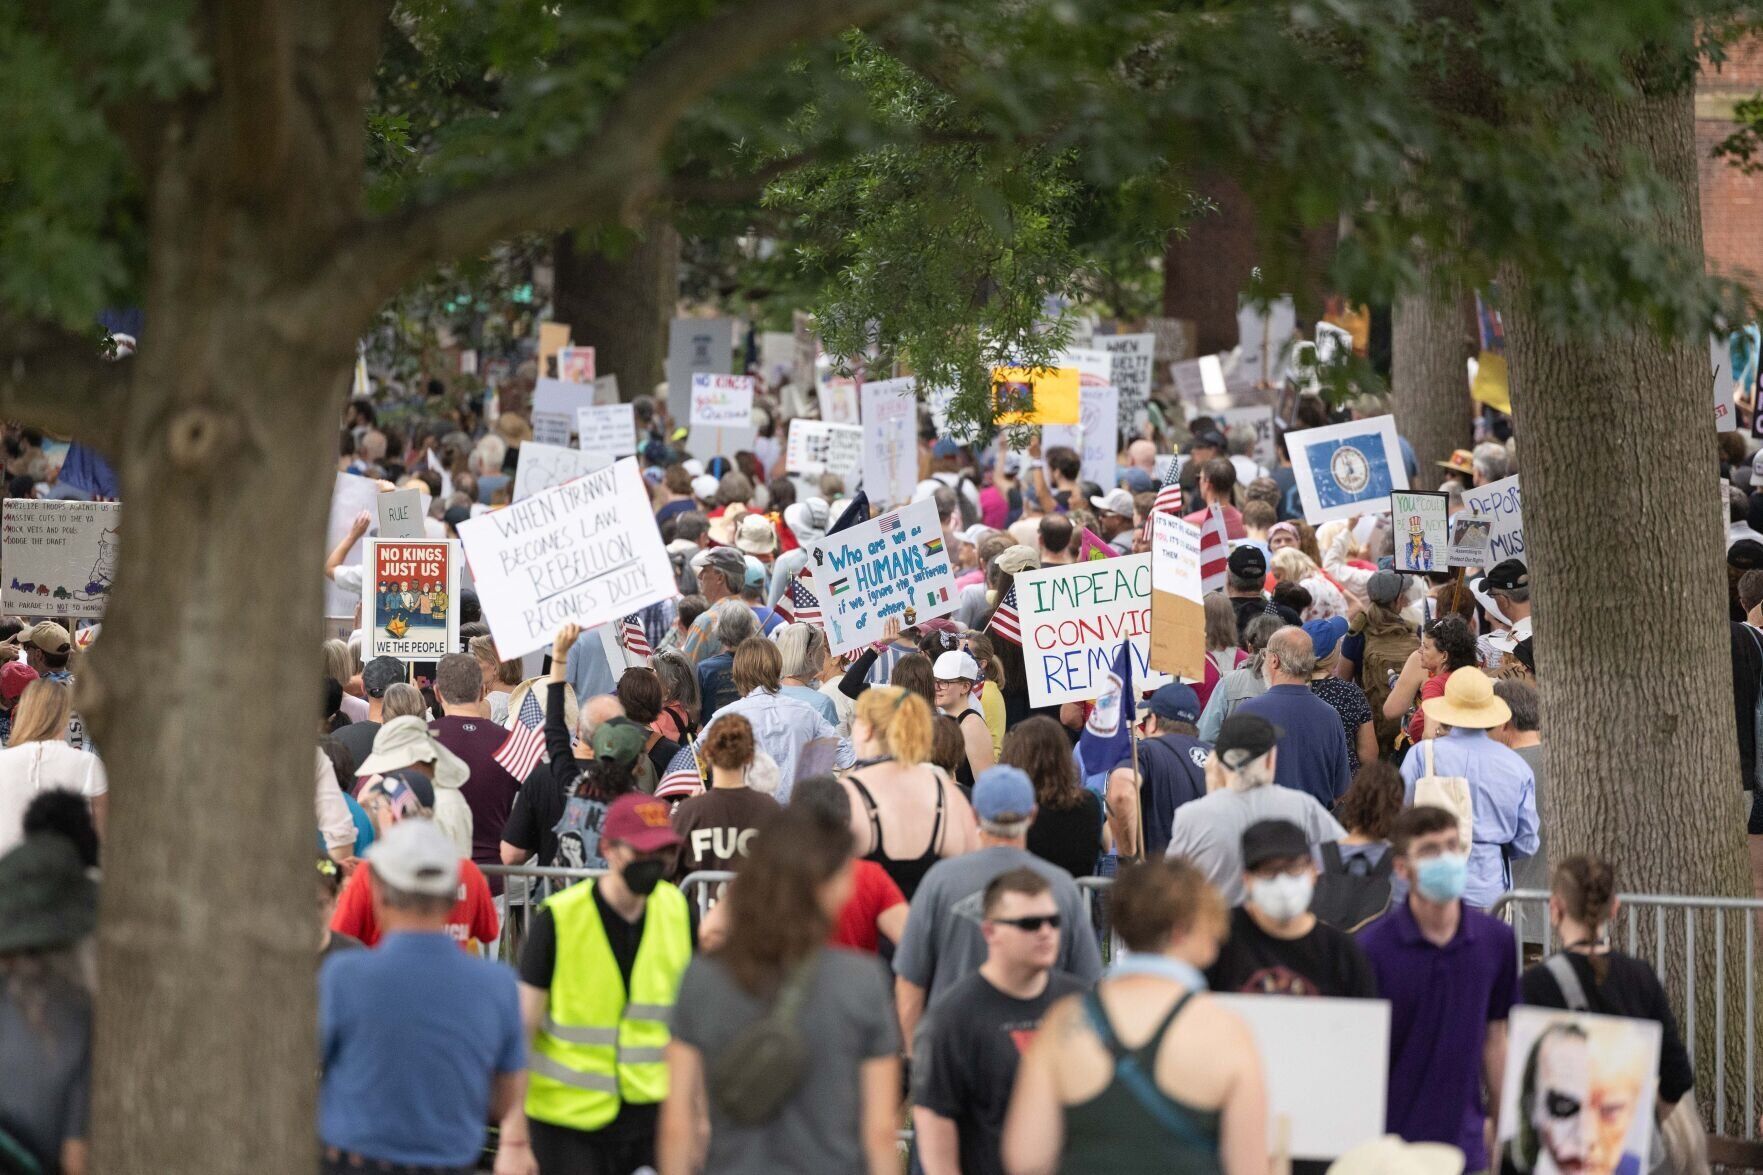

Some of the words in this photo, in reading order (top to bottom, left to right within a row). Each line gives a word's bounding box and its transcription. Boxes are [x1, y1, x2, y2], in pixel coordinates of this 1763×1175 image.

[69, 502, 97, 511] AGAINST
[388, 506, 408, 522] RULE
[492, 493, 558, 538] WHEN
[557, 466, 619, 514] TYRANNY
[381, 548, 400, 560] NO
[402, 548, 444, 562] KINGS,
[499, 526, 574, 576] BECOMES
[527, 532, 634, 597] REBELLION
[828, 544, 863, 572] Who
[868, 538, 886, 556] are
[892, 530, 906, 545] we
[911, 526, 922, 537] as
[854, 544, 924, 592] HUMANS
[1490, 529, 1524, 562] MUS
[381, 562, 417, 576] JUST
[421, 562, 440, 576] US
[838, 599, 846, 615] if
[849, 596, 864, 610] we
[867, 584, 894, 606] ignore
[896, 578, 910, 592] the
[913, 564, 948, 583] suffering
[1029, 565, 1151, 614] IMPEAC
[522, 590, 598, 639] BECOMES
[856, 612, 868, 630] of
[877, 600, 906, 618] others
[376, 642, 390, 652] WE
[393, 642, 410, 652] THE
[412, 642, 444, 653] PEOPLE
[1043, 642, 1152, 694] REMV
[690, 826, 761, 862] FUC
